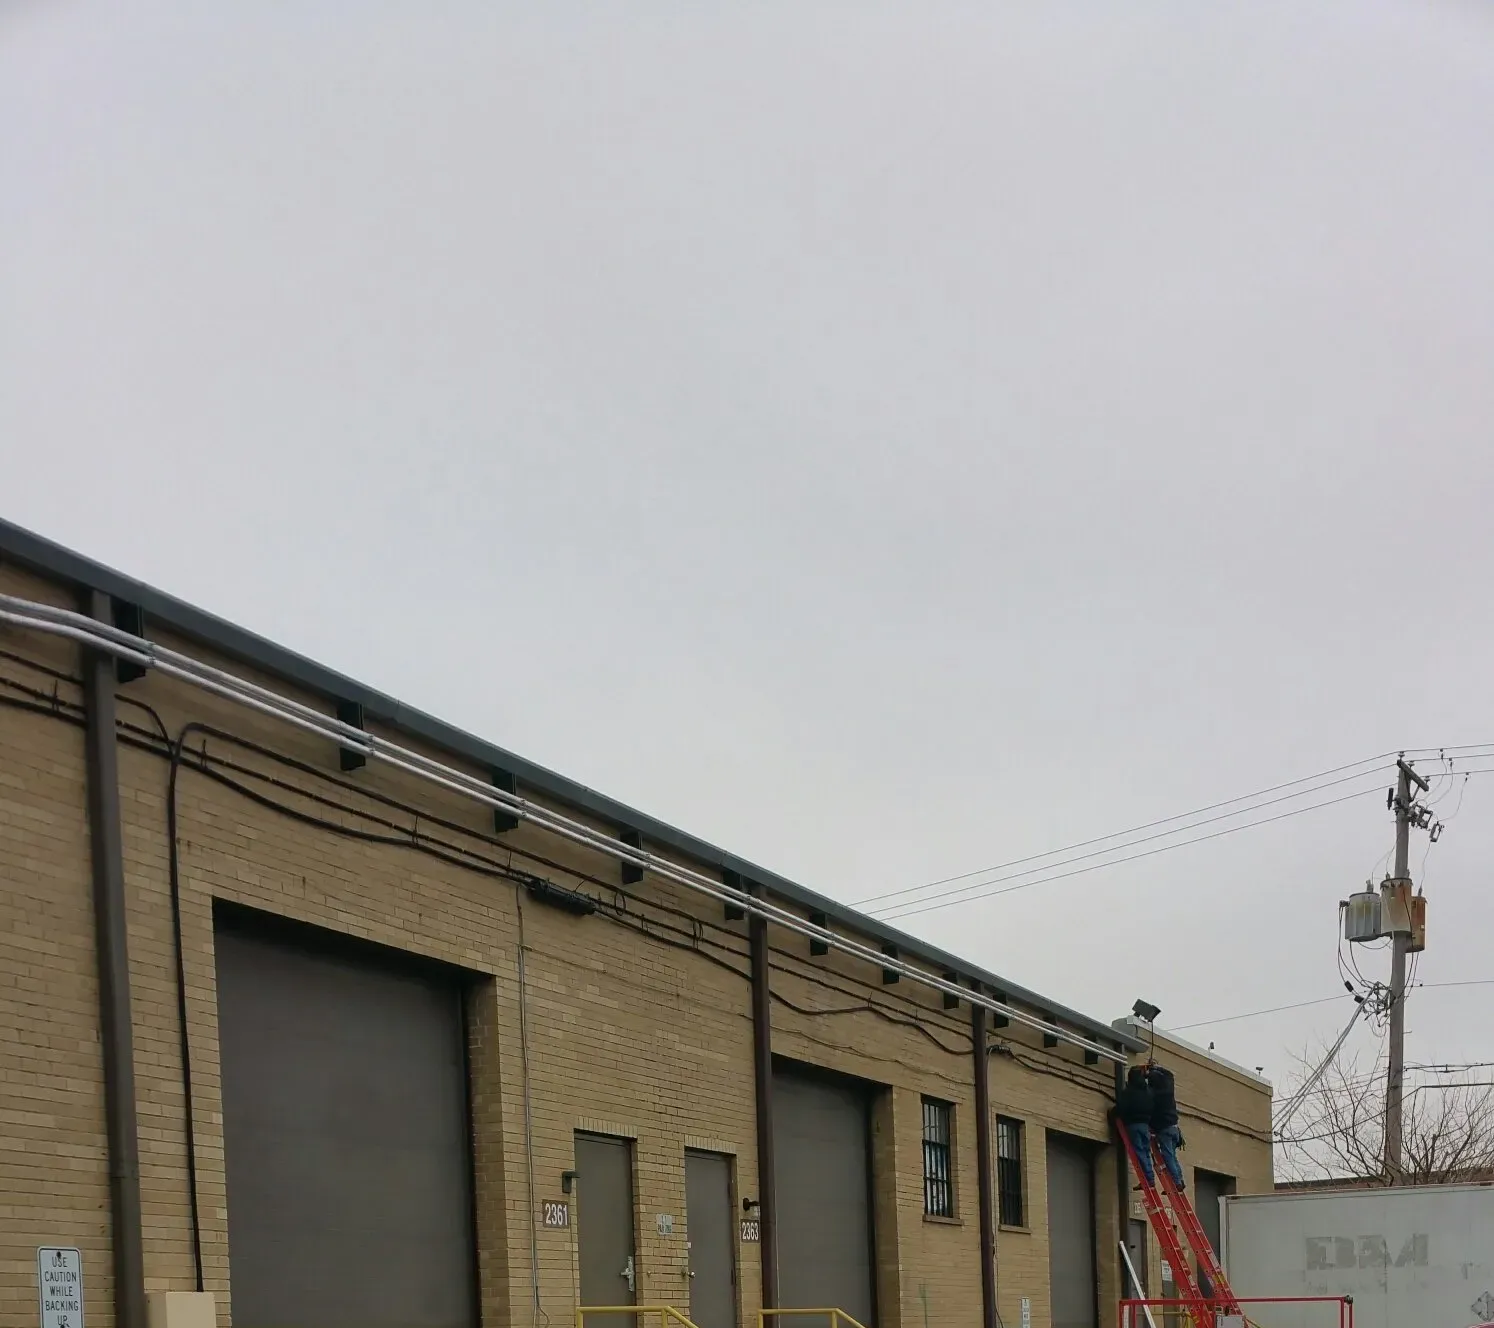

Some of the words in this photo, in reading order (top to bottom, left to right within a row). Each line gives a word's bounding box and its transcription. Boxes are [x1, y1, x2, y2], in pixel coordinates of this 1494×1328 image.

[544, 1202, 568, 1226] 2361
[741, 1221, 759, 1241] 2363
[51, 1256, 68, 1268] USE
[44, 1271, 77, 1282] CAUTION
[49, 1286, 73, 1297] WHILE
[45, 1300, 79, 1312] BACKING
[57, 1315, 68, 1326] UP
